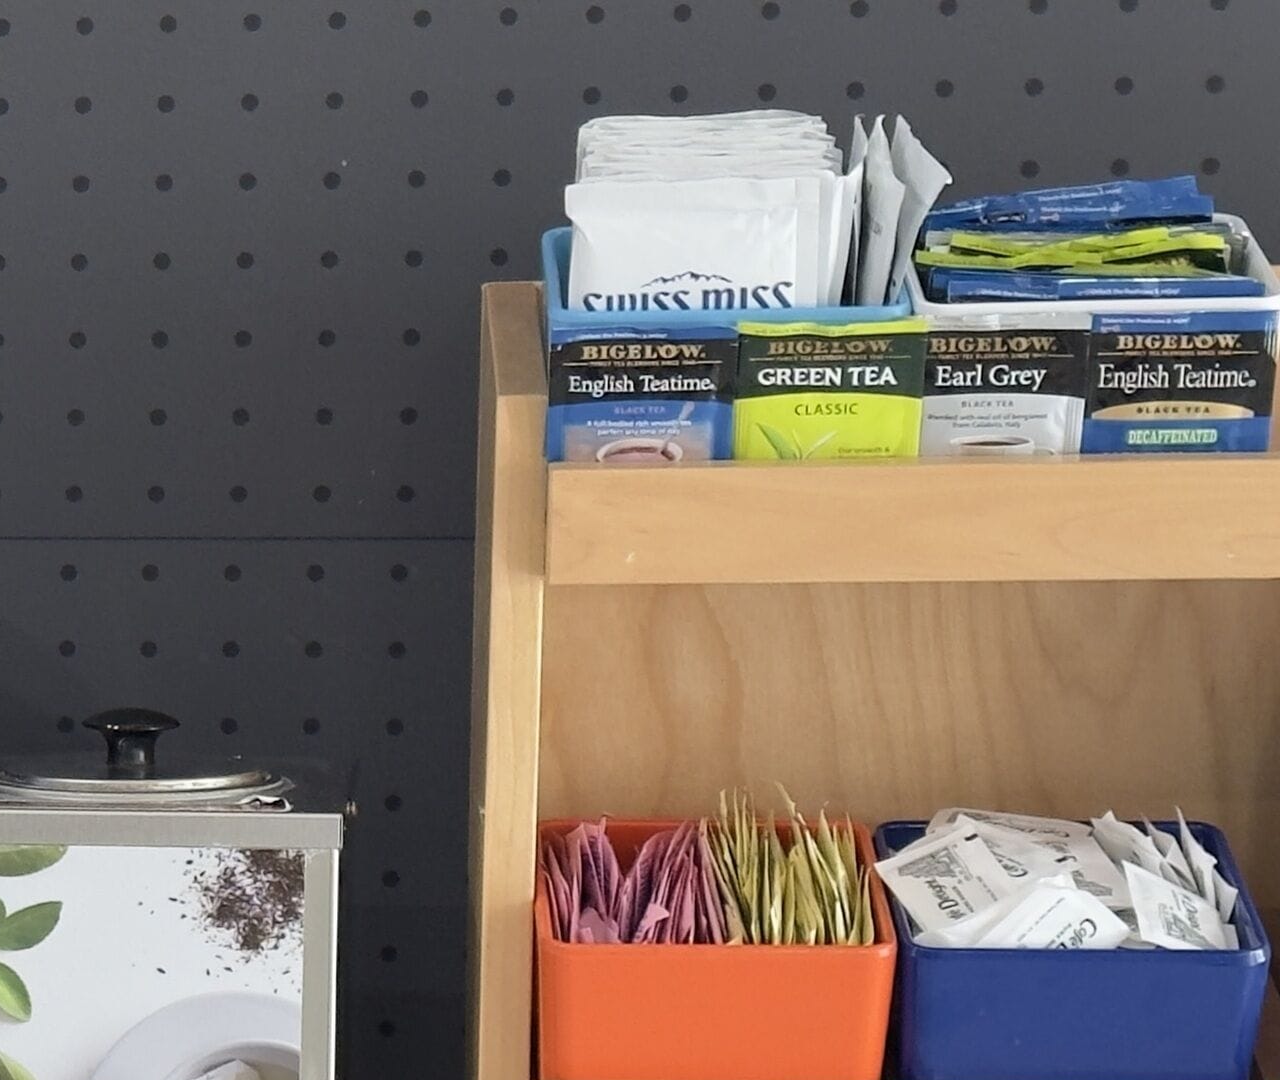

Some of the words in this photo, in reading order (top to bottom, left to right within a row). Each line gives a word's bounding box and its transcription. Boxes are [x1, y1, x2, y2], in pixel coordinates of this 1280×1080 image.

[757, 367, 842, 386] GREEN
[848, 366, 898, 386] TEA
[935, 364, 983, 387] Earl
[989, 364, 1047, 392] Grey
[1097, 363, 1169, 394] English
[568, 375, 635, 398] English
[794, 403, 859, 416] CLASSIC
[961, 400, 992, 409] BLACK
[996, 400, 1014, 408] TEA
[1136, 406, 1179, 414] BLACK
[1128, 429, 1218, 445] DECAFFEINATED
